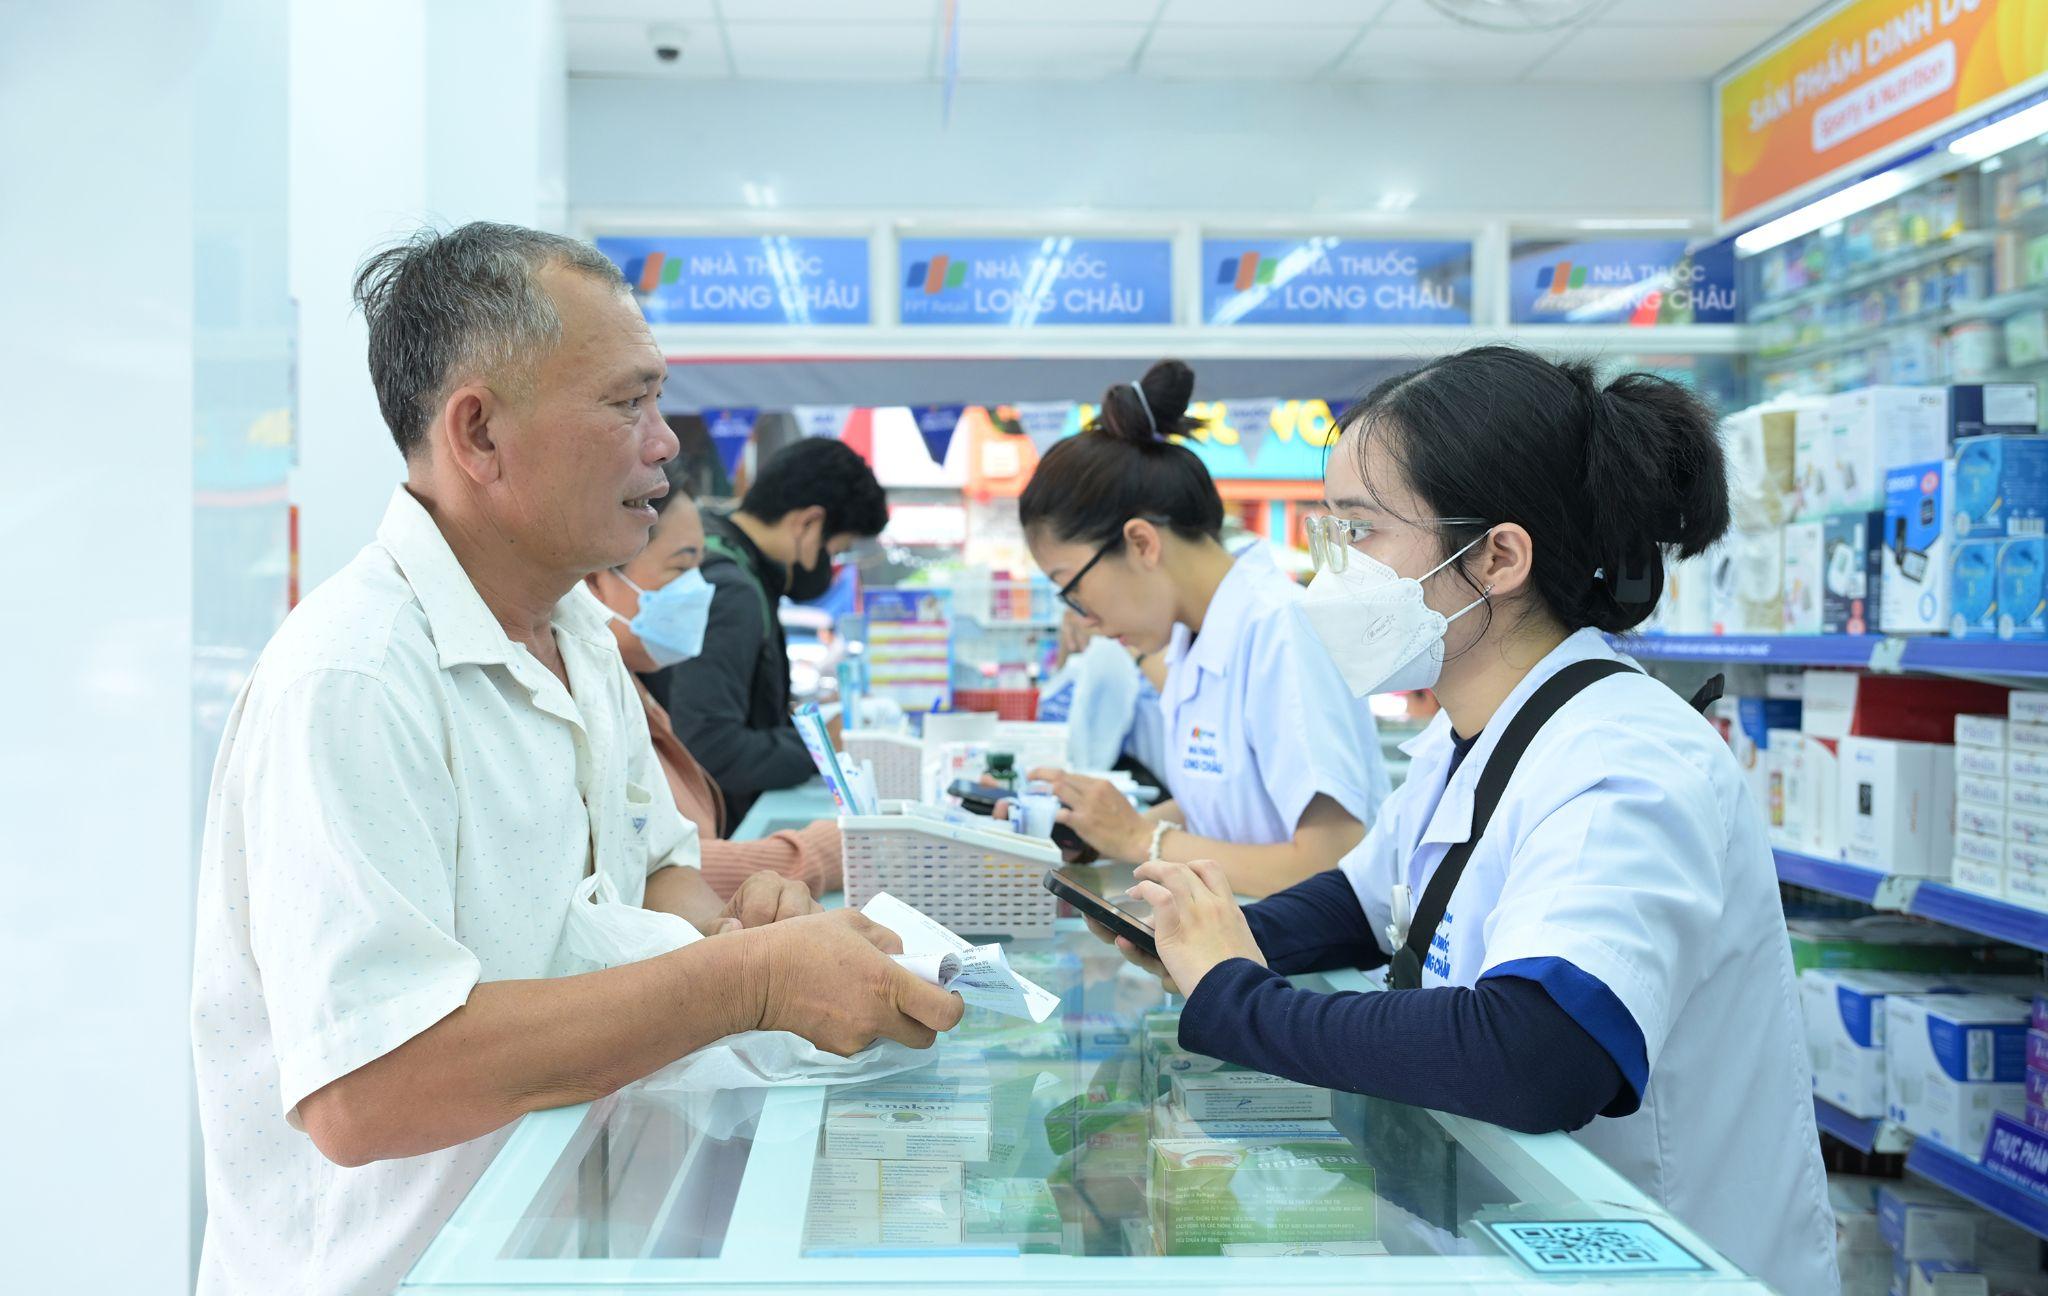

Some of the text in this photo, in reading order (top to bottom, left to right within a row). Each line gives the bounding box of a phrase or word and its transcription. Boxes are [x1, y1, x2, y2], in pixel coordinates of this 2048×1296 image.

[1867, 0, 1933, 66] DINH
[1940, 0, 1982, 25] D
[690, 251, 738, 276] NHÀ
[975, 256, 1023, 279] NHÀ
[1286, 249, 1418, 276] HÀ THUỐC
[1593, 261, 1633, 281] NHÀ
[690, 285, 773, 310] LONG
[975, 282, 1144, 313] LONG CHÂU
[1285, 286, 1367, 310] LONG
[1374, 279, 1454, 310] CHÂU
[1668, 284, 1736, 310] CHÂU
[864, 1102, 952, 1111] tanakan
